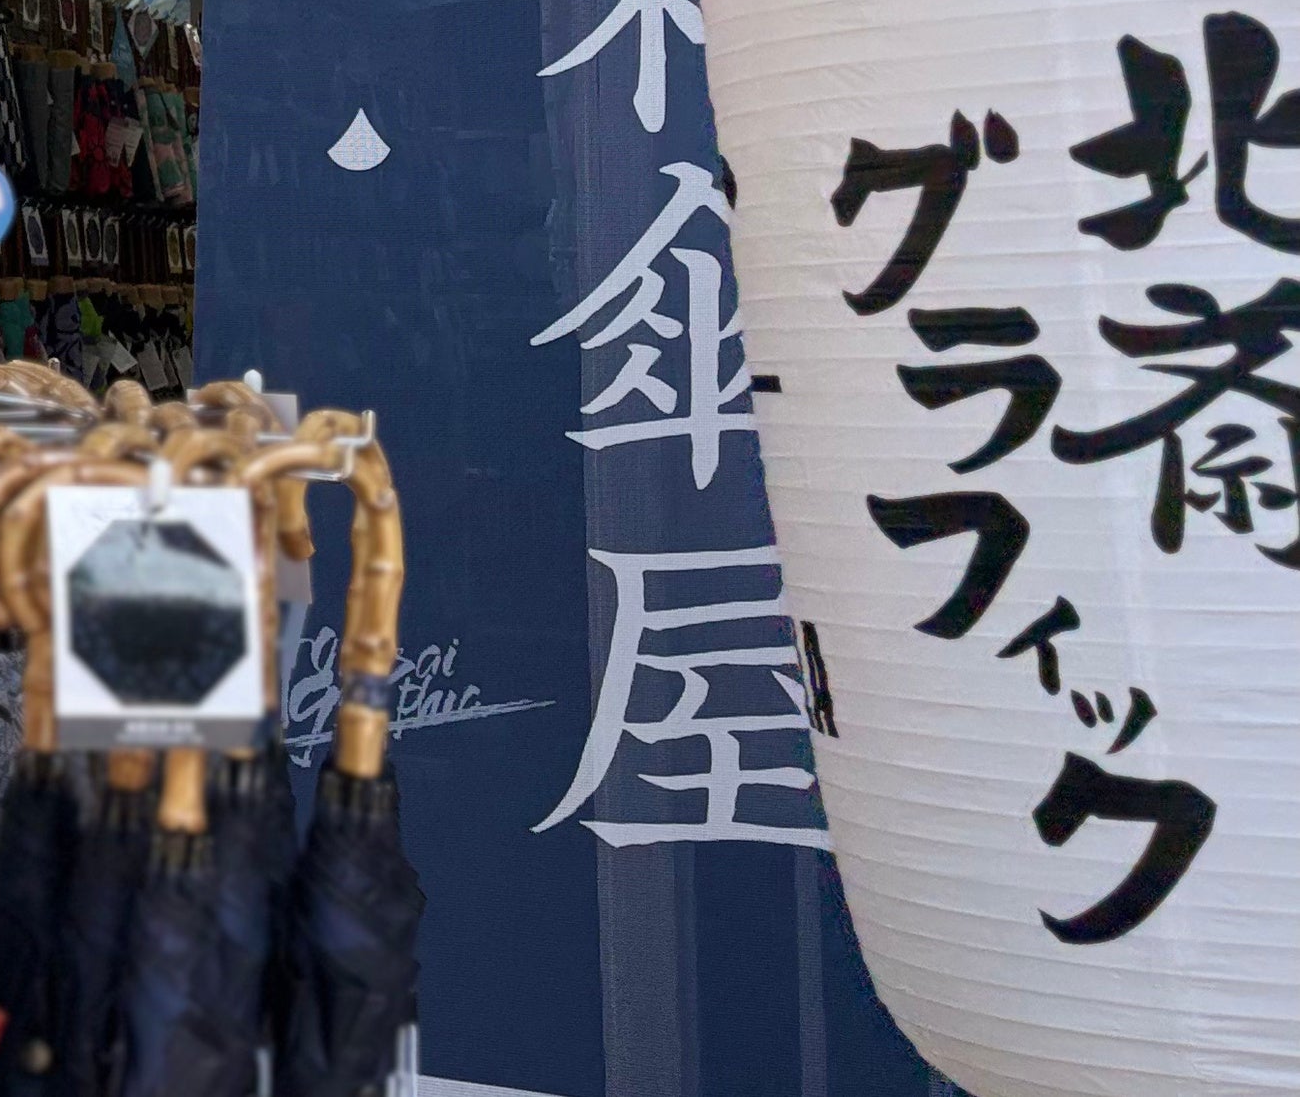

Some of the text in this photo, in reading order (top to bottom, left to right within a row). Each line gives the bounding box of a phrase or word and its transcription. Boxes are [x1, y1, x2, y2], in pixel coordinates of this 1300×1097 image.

[832, 107, 1218, 946] グラフィック
